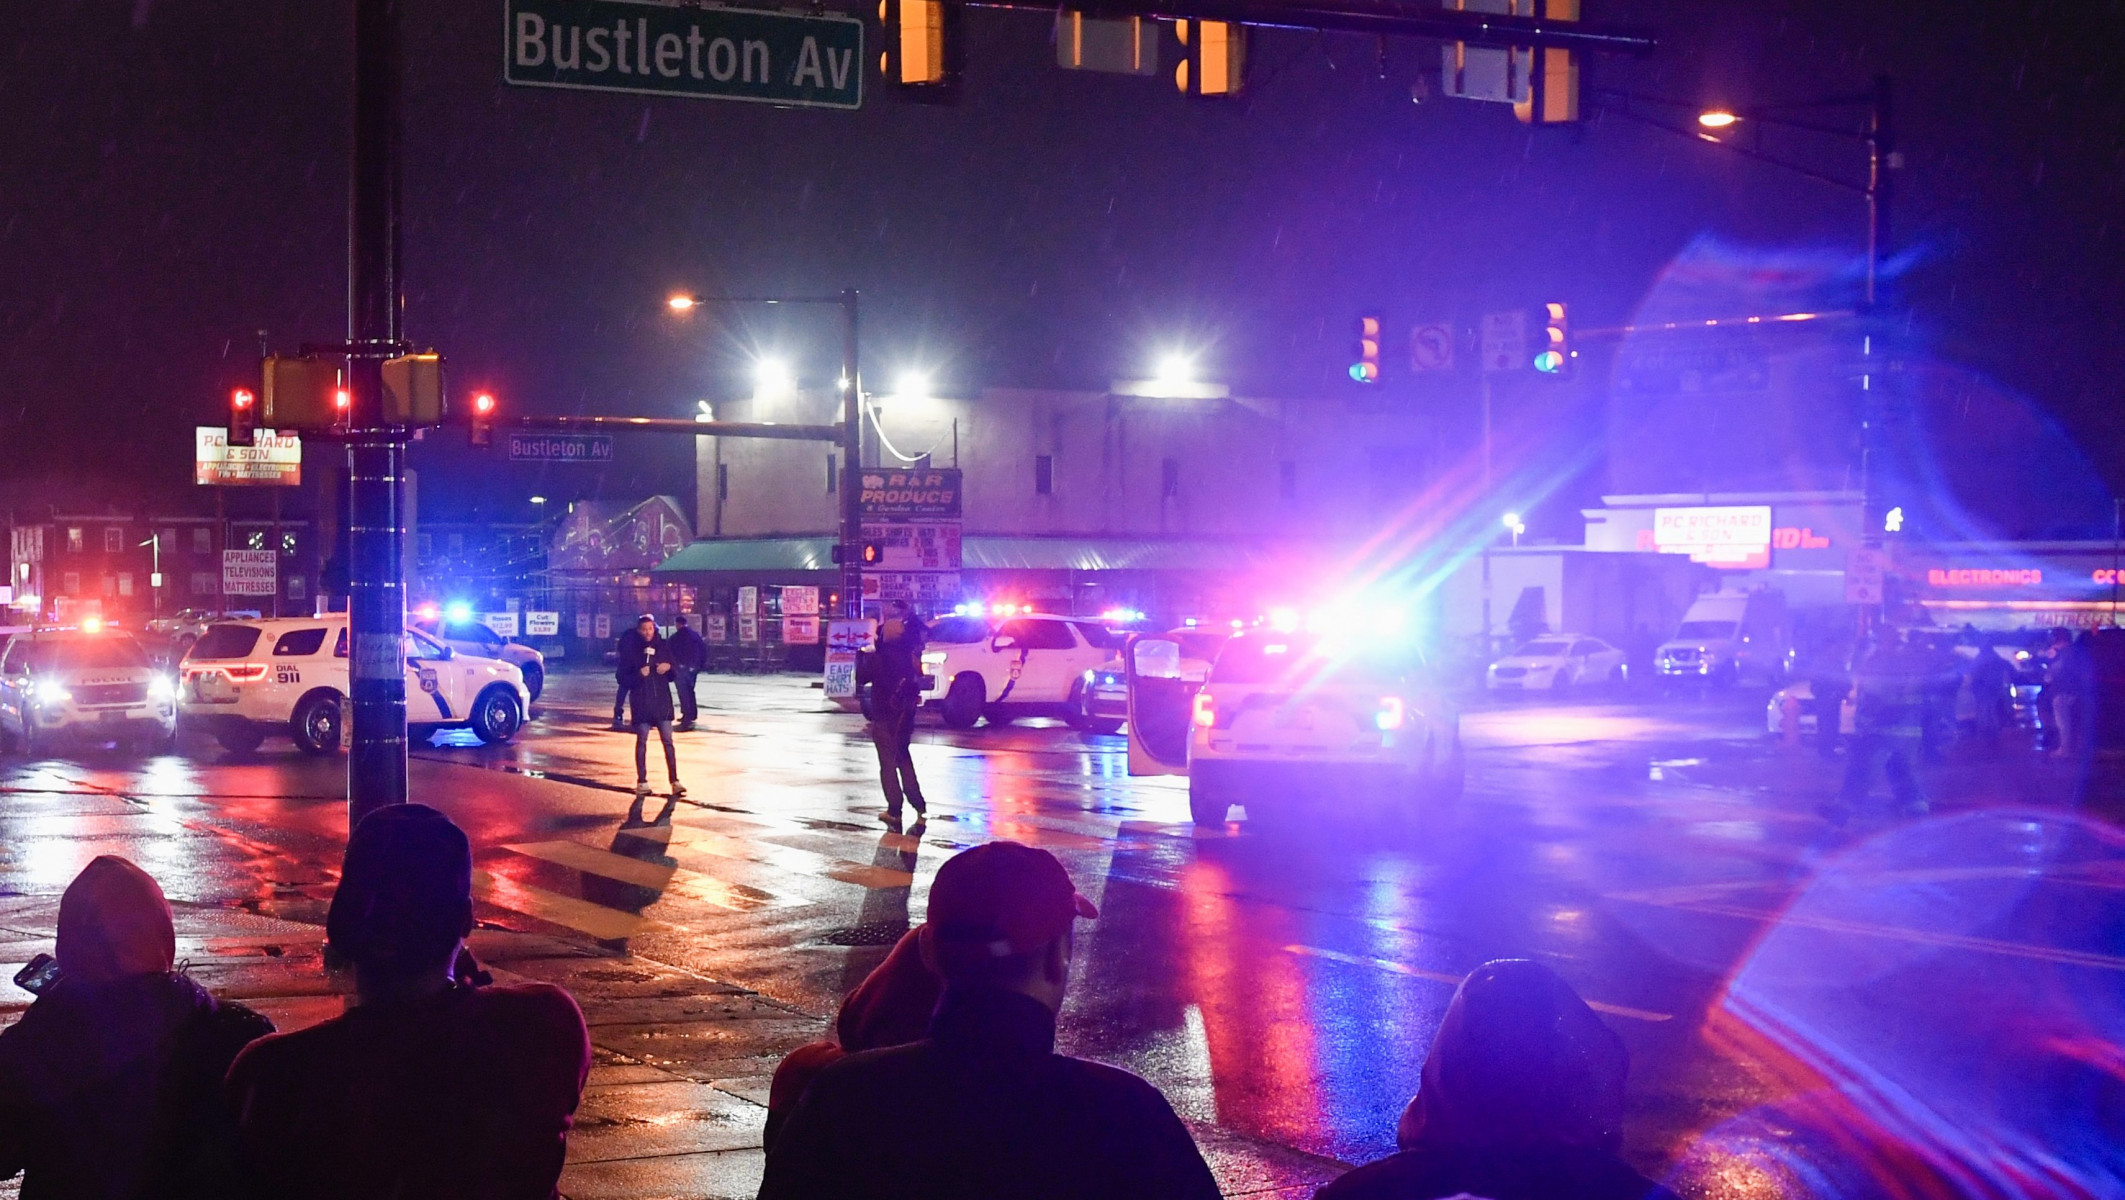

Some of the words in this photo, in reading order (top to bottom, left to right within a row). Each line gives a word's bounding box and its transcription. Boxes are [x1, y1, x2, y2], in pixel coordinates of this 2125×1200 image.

[516, 12, 769, 84] Bustleton
[792, 35, 852, 90] Av
[254, 437, 294, 448] HARD
[239, 448, 270, 460] SON
[512, 440, 586, 456] Bustleton
[591, 441, 610, 457] Av
[889, 474, 907, 486] R
[925, 474, 943, 486] R
[860, 490, 954, 504] PRODUCE
[1688, 514, 1763, 527] RICHARD
[225, 552, 275, 563] APPLIANCES
[225, 566, 275, 577] TELEVISIONS
[1928, 569, 2042, 584] ELECTRONICS
[225, 581, 275, 592] MATTRESSES
[81, 676, 132, 684] POLICE
[277, 673, 301, 684] 911
[826, 684, 850, 694] HATS
